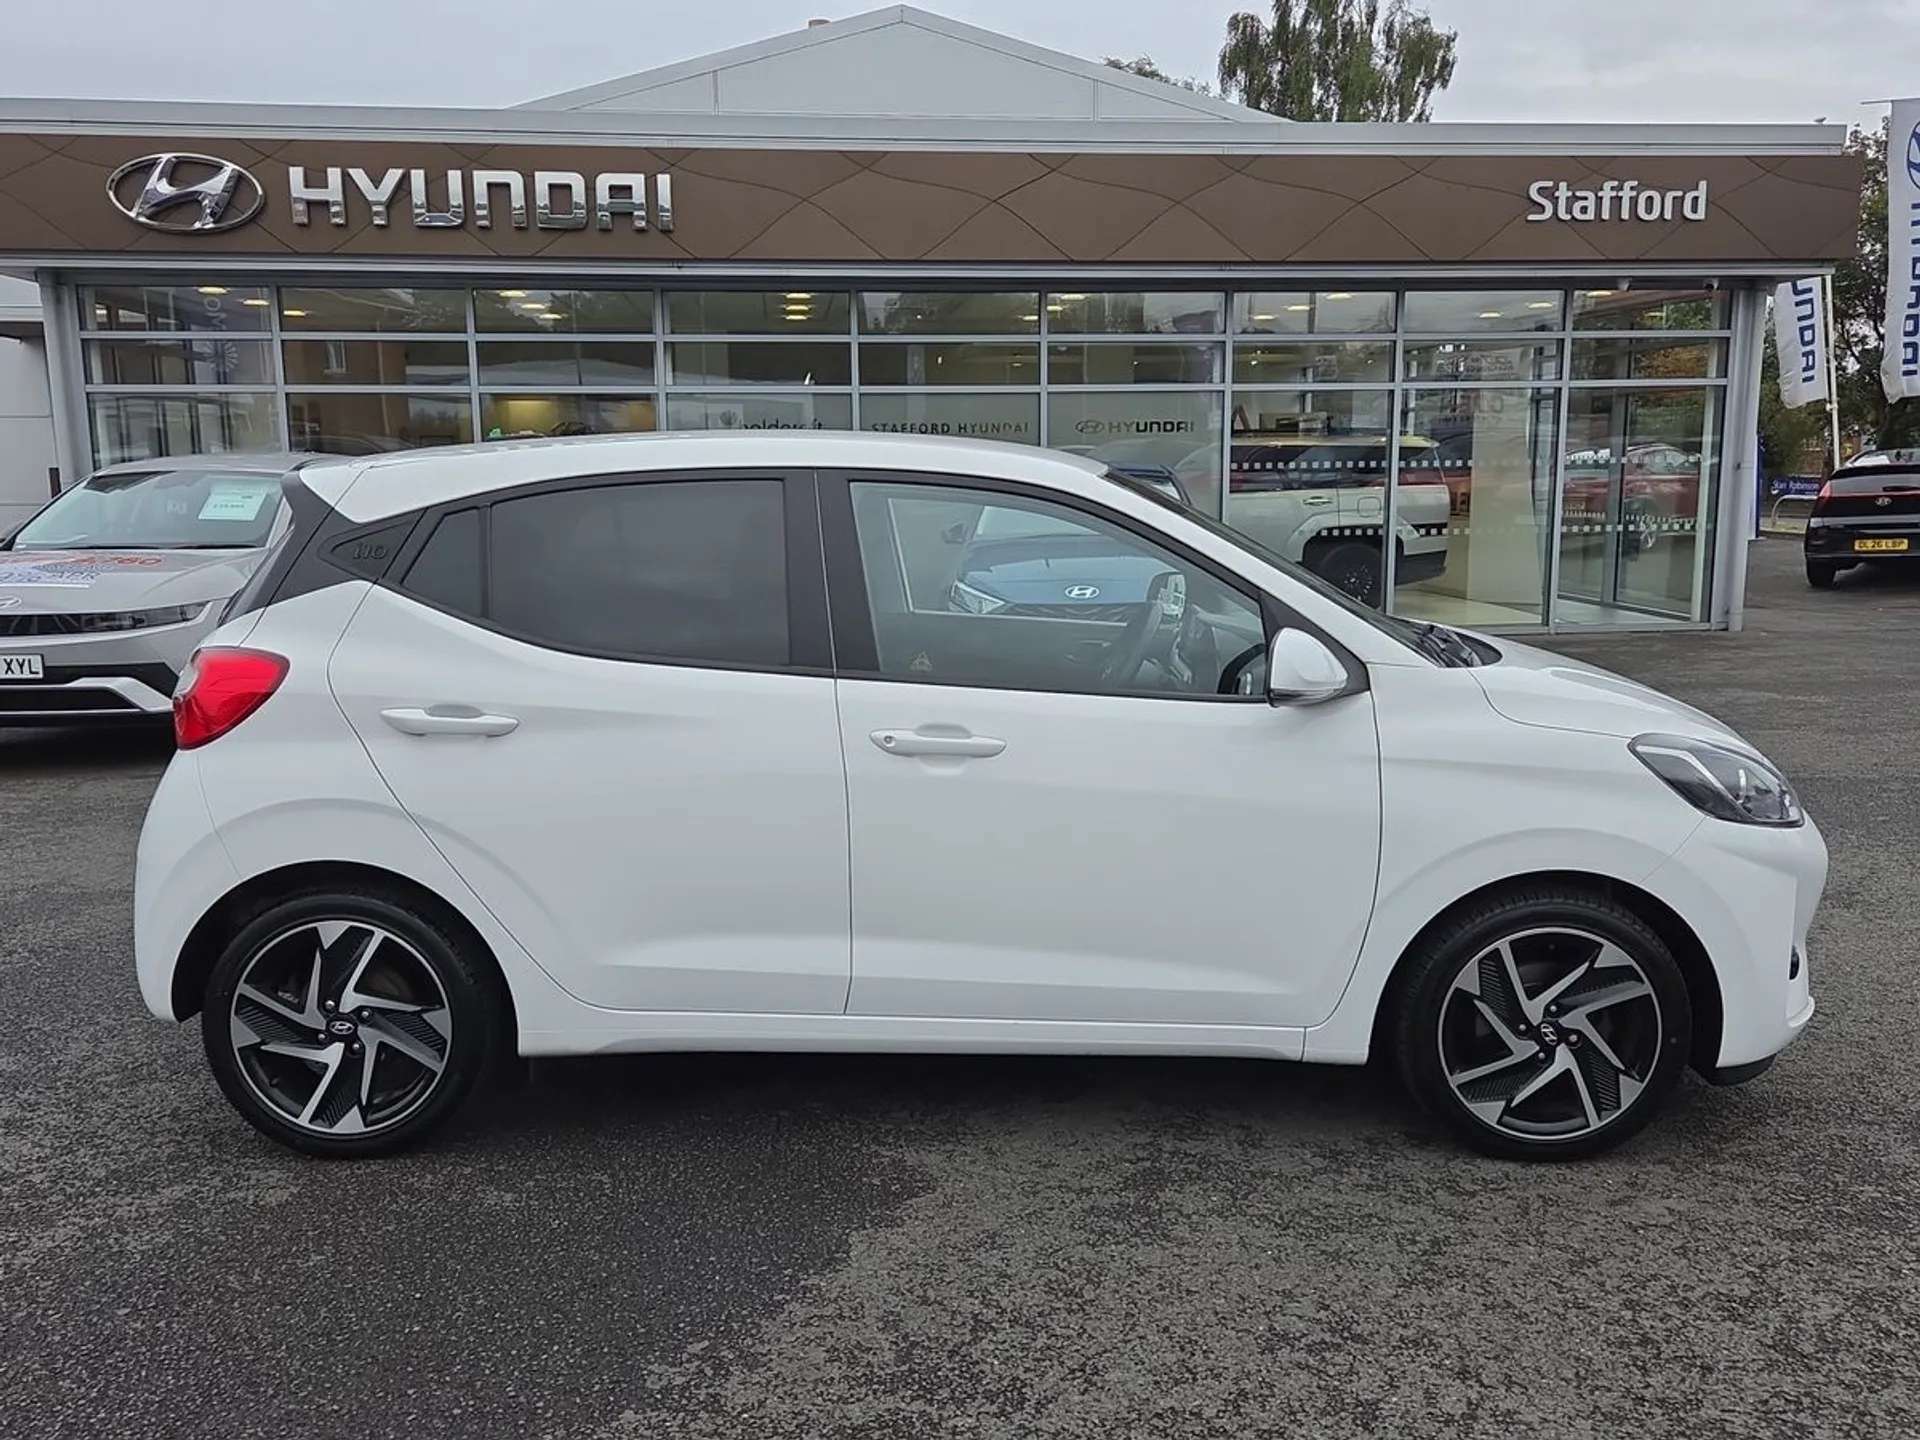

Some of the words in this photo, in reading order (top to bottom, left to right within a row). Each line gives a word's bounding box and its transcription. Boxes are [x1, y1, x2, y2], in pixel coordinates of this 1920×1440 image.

[288, 166, 673, 232] HYUNDAI
[1526, 180, 1708, 221] Stafford
[871, 422, 950, 434] STAFFORD
[957, 422, 1029, 433] HYUNDAI
[1108, 420, 1195, 432] HYUNDAI
[3, 658, 41, 675] XYL
